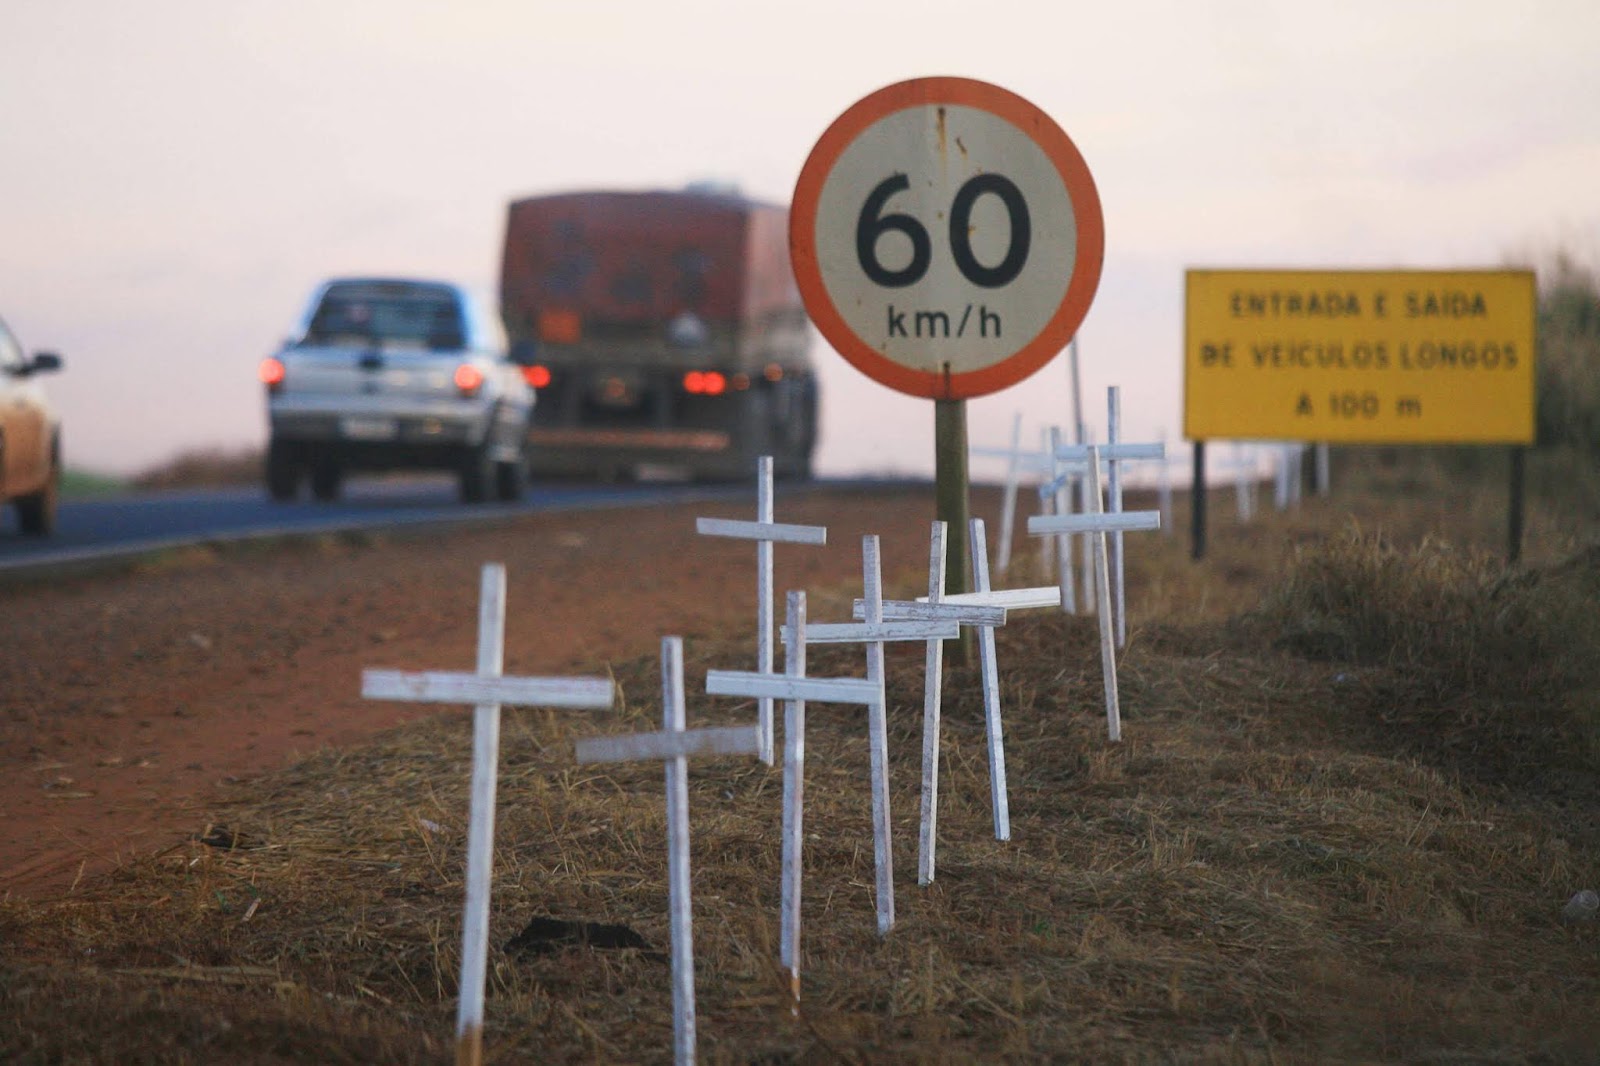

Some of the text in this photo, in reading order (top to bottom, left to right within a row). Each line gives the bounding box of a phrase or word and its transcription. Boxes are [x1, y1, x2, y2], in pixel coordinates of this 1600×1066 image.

[857, 172, 1031, 288] 60
[1230, 291, 1361, 318] ENTRADA
[1373, 291, 1387, 318] E
[888, 304, 1001, 338] km/h
[1200, 343, 1232, 368] DE
[1401, 342, 1519, 370] LONGOS
[1296, 393, 1422, 418] A 100 m
